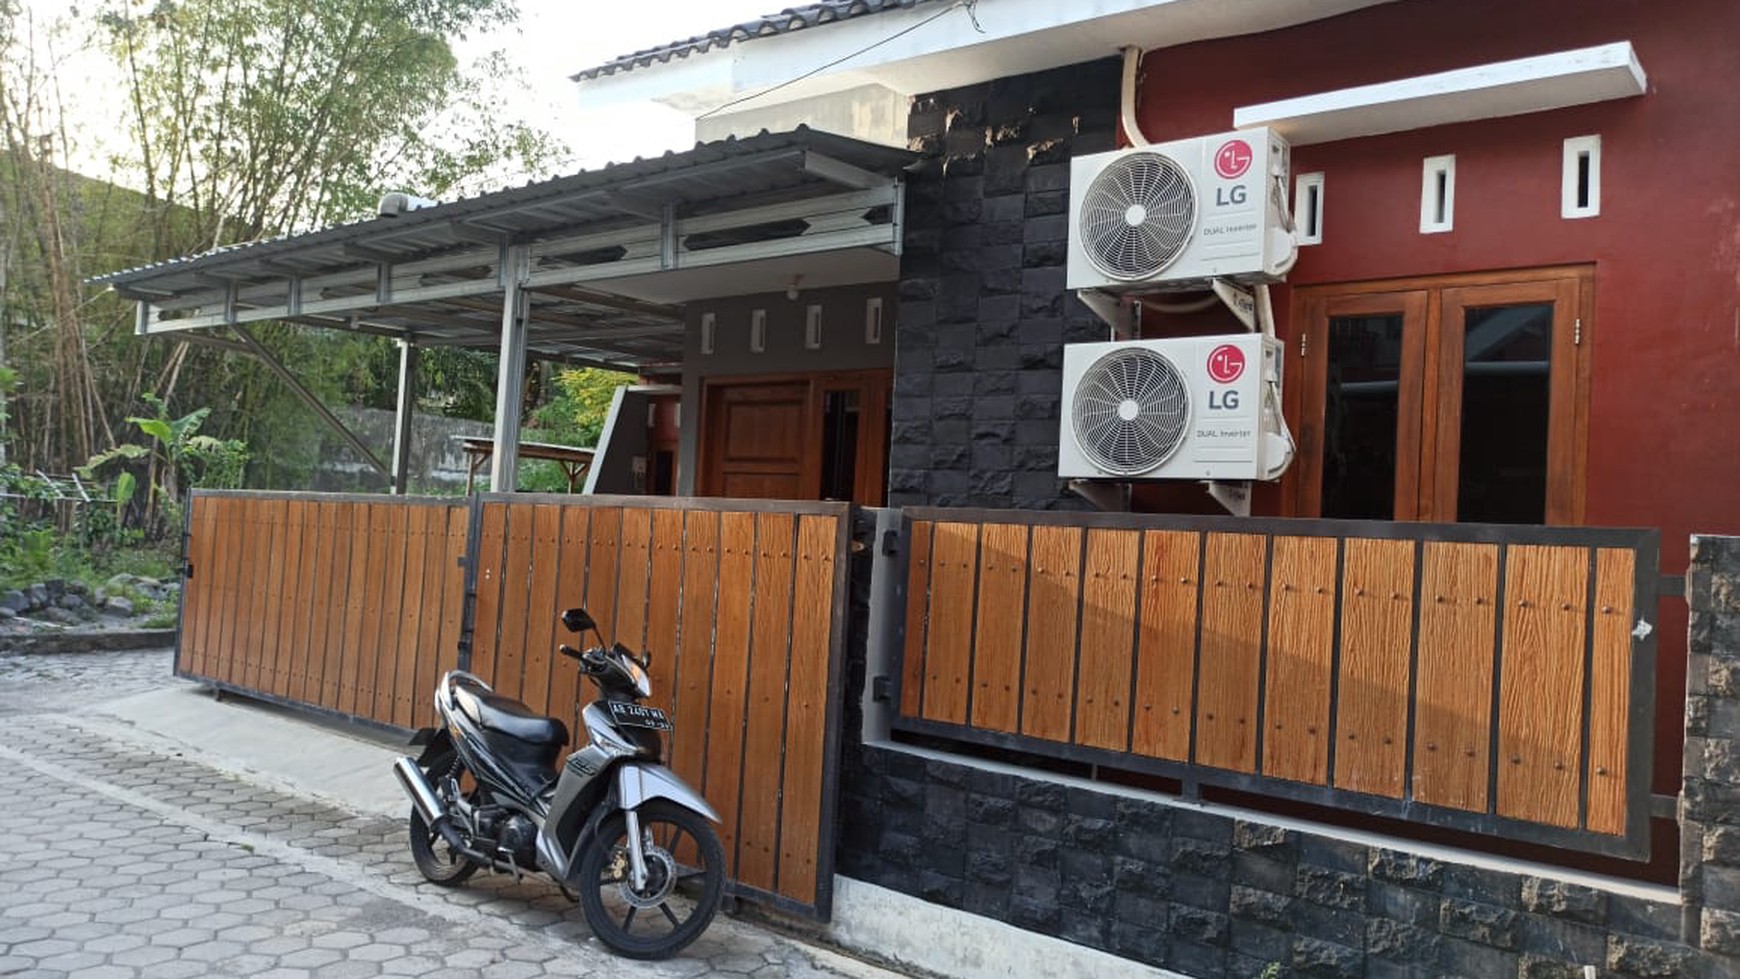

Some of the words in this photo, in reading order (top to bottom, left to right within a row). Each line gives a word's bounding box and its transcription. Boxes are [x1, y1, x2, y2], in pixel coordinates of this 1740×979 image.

[1216, 185, 1247, 206] LG
[1203, 226, 1225, 236] DUAL
[1209, 390, 1239, 410] LG
[1196, 429, 1219, 438] DUAL
